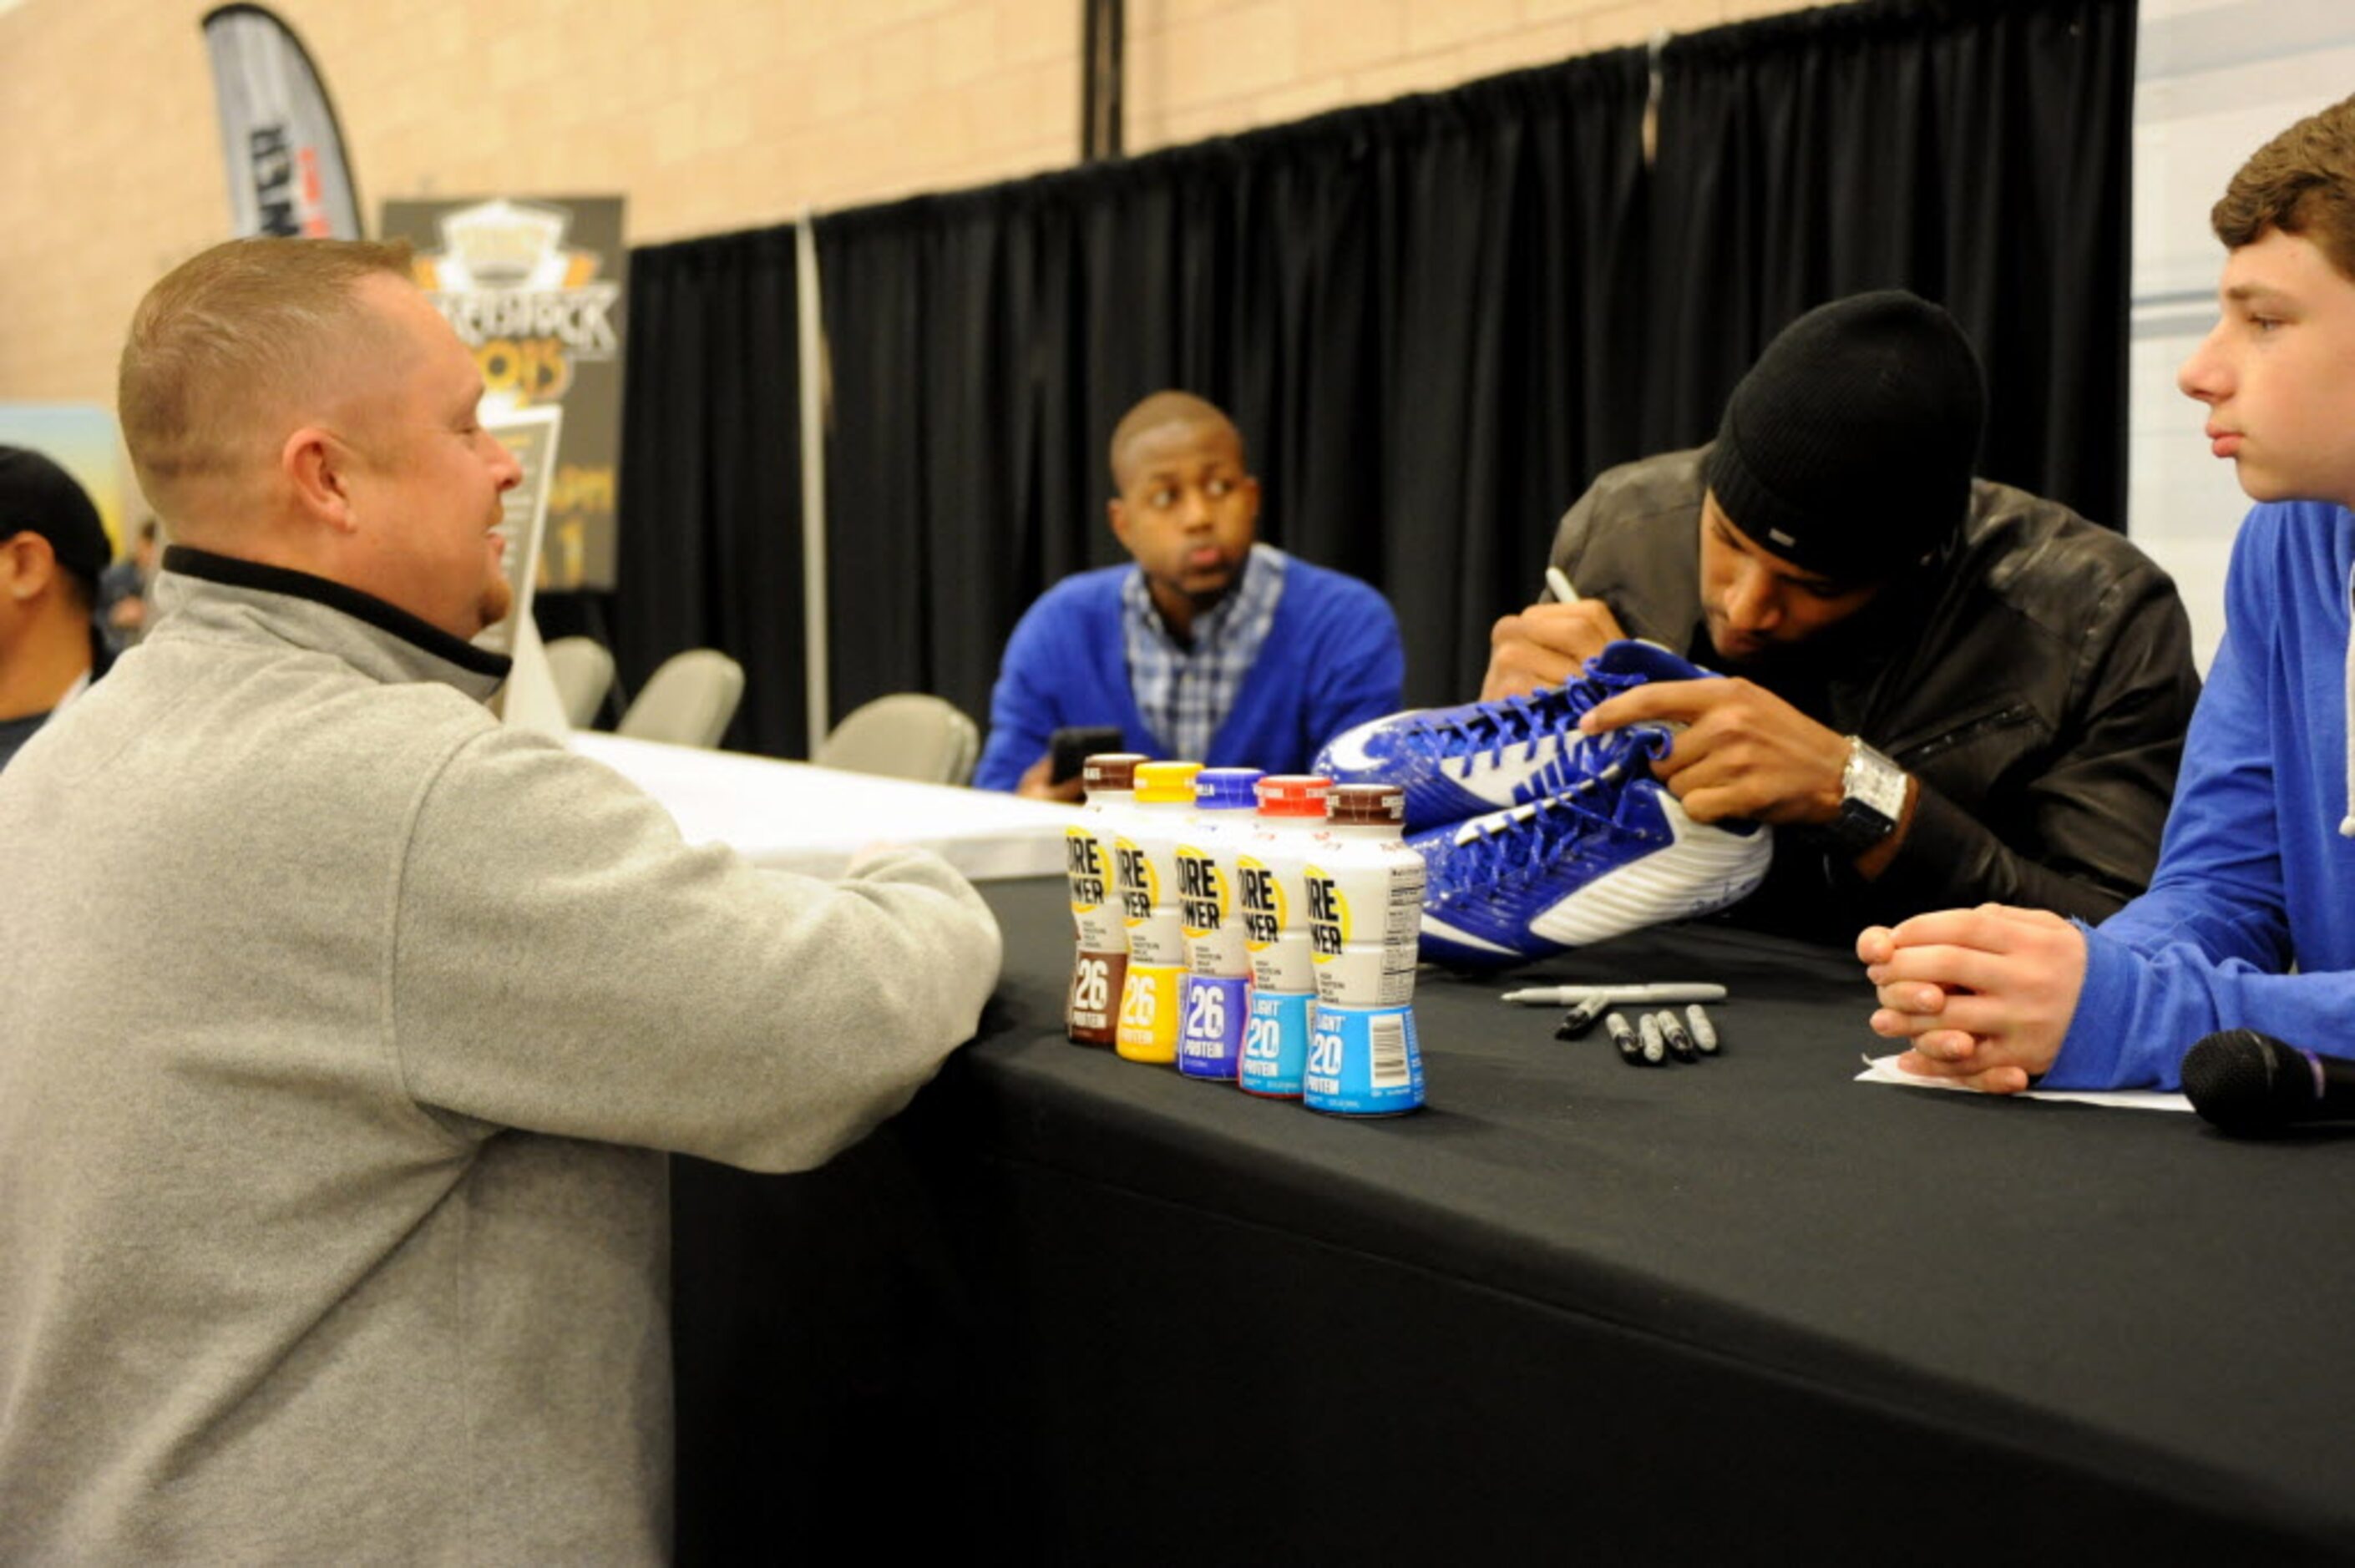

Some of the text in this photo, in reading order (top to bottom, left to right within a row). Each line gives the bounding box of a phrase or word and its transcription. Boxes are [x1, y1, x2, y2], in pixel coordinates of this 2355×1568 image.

[1075, 959, 1108, 1010] 26
[1122, 974, 1156, 1026] 26
[1187, 985, 1224, 1039] 26
[1247, 1018, 1279, 1058] 20
[1310, 1033, 1342, 1075] 20
